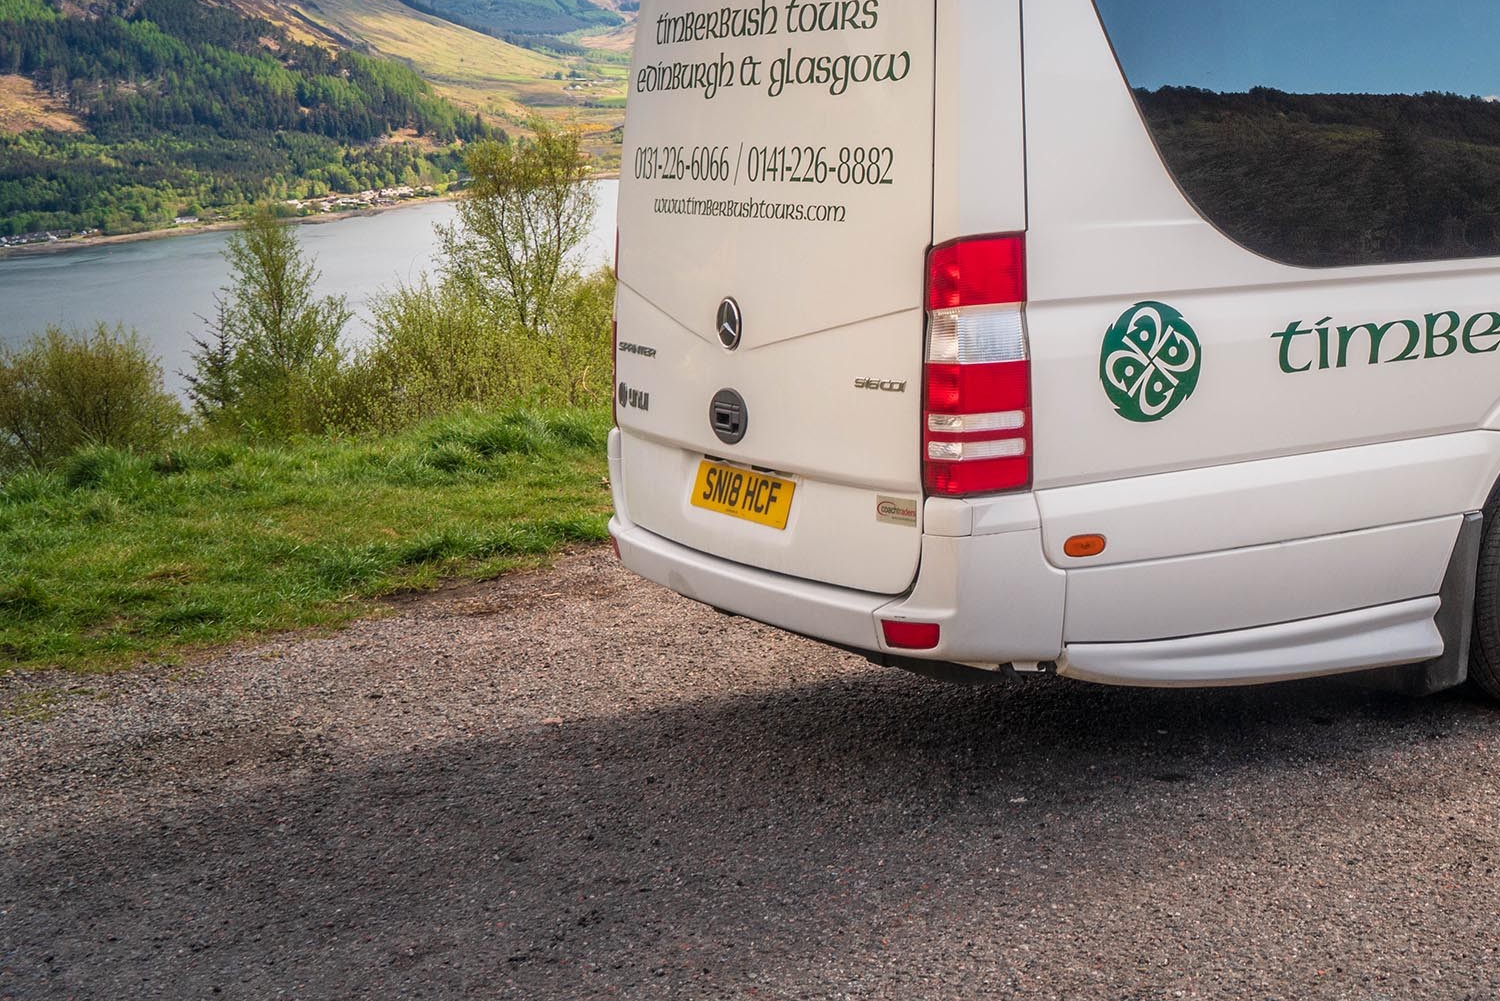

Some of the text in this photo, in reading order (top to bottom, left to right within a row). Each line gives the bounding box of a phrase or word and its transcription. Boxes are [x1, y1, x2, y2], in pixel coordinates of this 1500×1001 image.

[767, 48, 911, 98] glasgow
[634, 142, 894, 186] 0131-226-6066 / 0141-226-8882
[654, 197, 846, 222] www.timberbushtours.com
[703, 467, 782, 515] SN18 HCF
